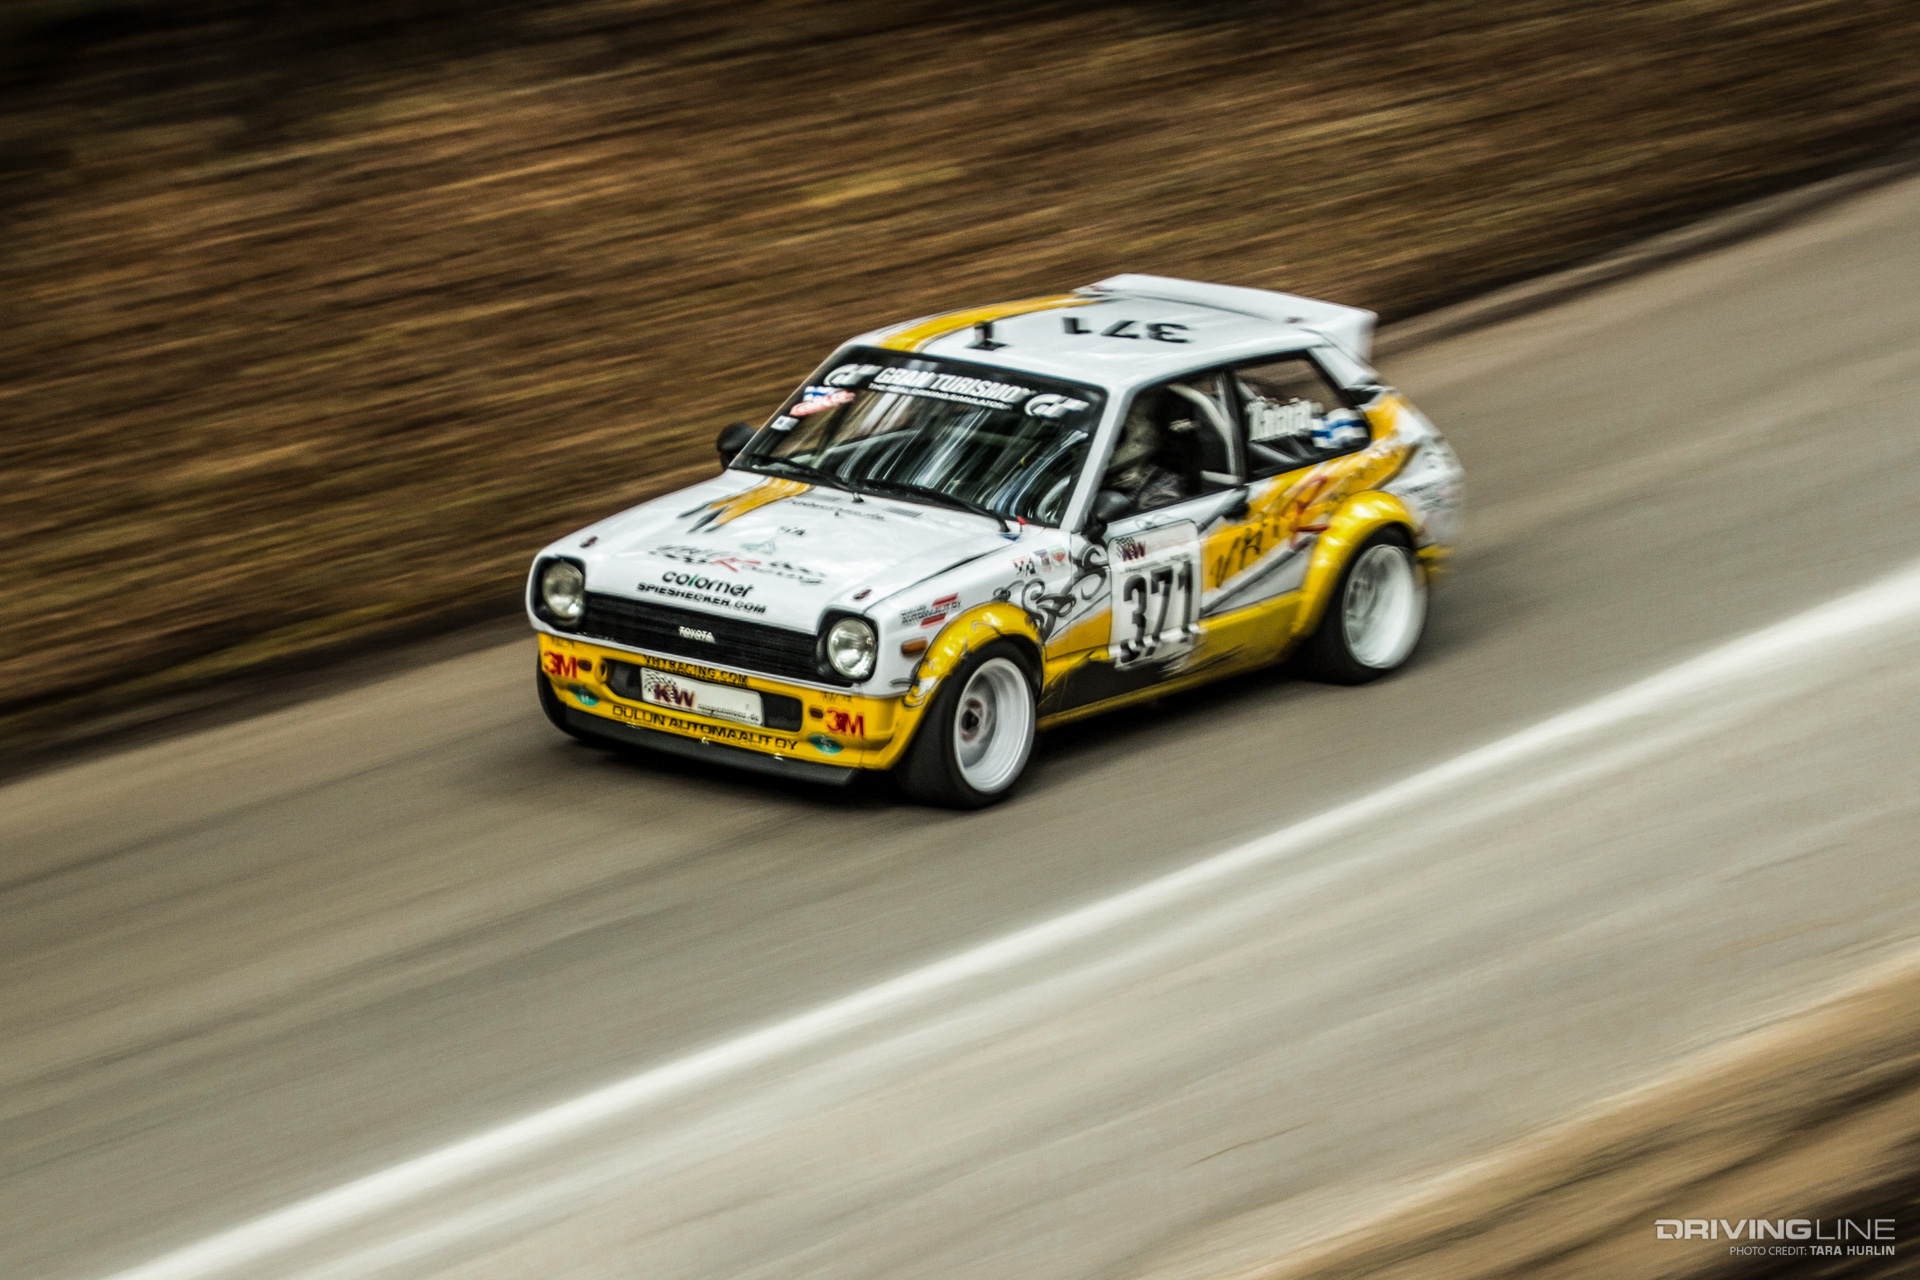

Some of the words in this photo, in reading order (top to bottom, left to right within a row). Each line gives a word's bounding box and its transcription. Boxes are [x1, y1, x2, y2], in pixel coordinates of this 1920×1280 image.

[875, 367, 937, 389] GRAN
[637, 582, 767, 614] SPIESHECKER.COM
[1120, 560, 1193, 664] 371
[679, 626, 716, 643] TOYOTA
[544, 650, 578, 679] 3M
[654, 682, 696, 710] KW
[612, 705, 665, 726] OULUN
[668, 717, 772, 746] AUTOMAALIT
[774, 738, 798, 750] OY
[826, 706, 866, 739] 3M
